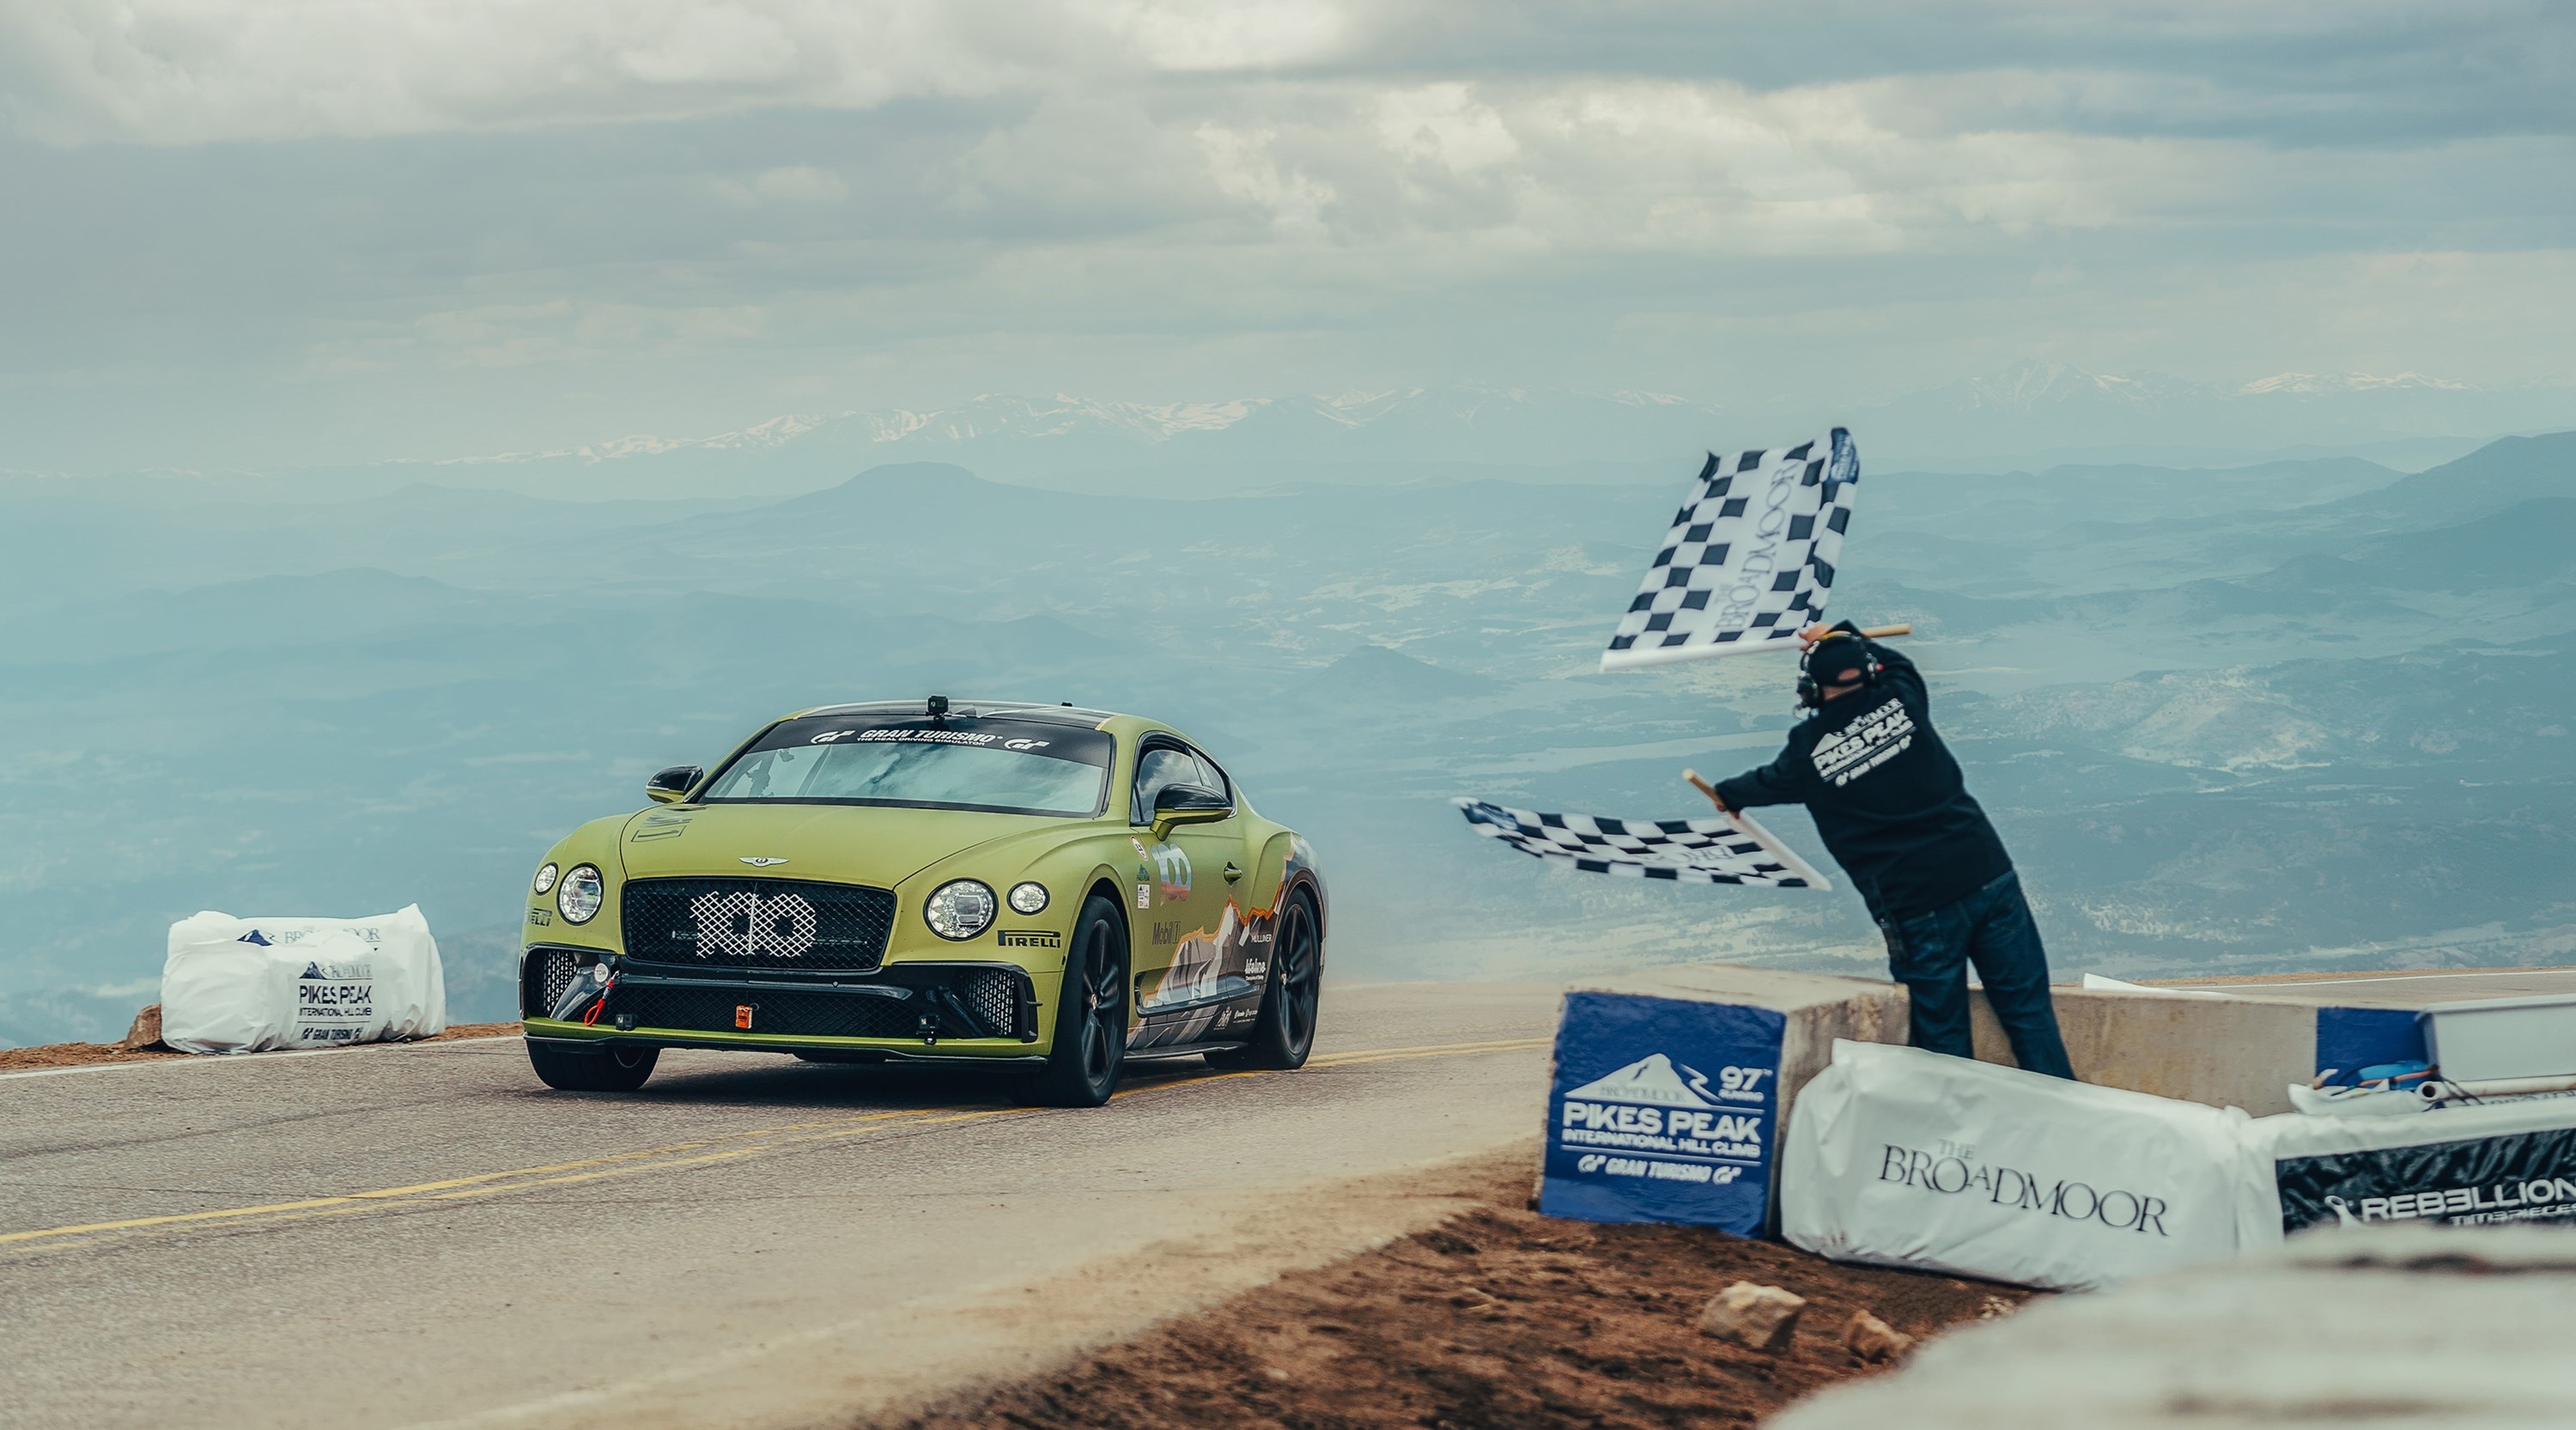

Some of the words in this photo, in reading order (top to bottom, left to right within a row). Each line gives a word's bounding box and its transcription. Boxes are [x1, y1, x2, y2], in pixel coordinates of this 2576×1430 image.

[1715, 461, 1799, 630] BROADMOOR
[860, 729, 914, 739] GRAN
[1814, 736, 1865, 771] PIKES
[1862, 709, 1909, 745] PEAK
[1150, 843, 1192, 907] 100
[690, 891, 817, 958] 100
[1152, 922, 1173, 945] Mobil
[1250, 934, 1273, 943] MULLINER
[997, 930, 1061, 949] PIRELLI
[299, 985, 337, 1004] PIKES
[340, 985, 372, 1004] PEAK
[1563, 1101, 1662, 1135] PIKES
[1668, 1110, 1761, 1144] PEAK
[1561, 1128, 1678, 1152] INTERNATIONAL
[1678, 1138, 1711, 1154] HILL
[1711, 1141, 1761, 1159] CLIMB
[1937, 1137, 1976, 1159] THE
[1605, 1157, 1648, 1177] GRAN
[1648, 1160, 1713, 1183] TURISMO
[1878, 1143, 2169, 1238] BROADMOOR
